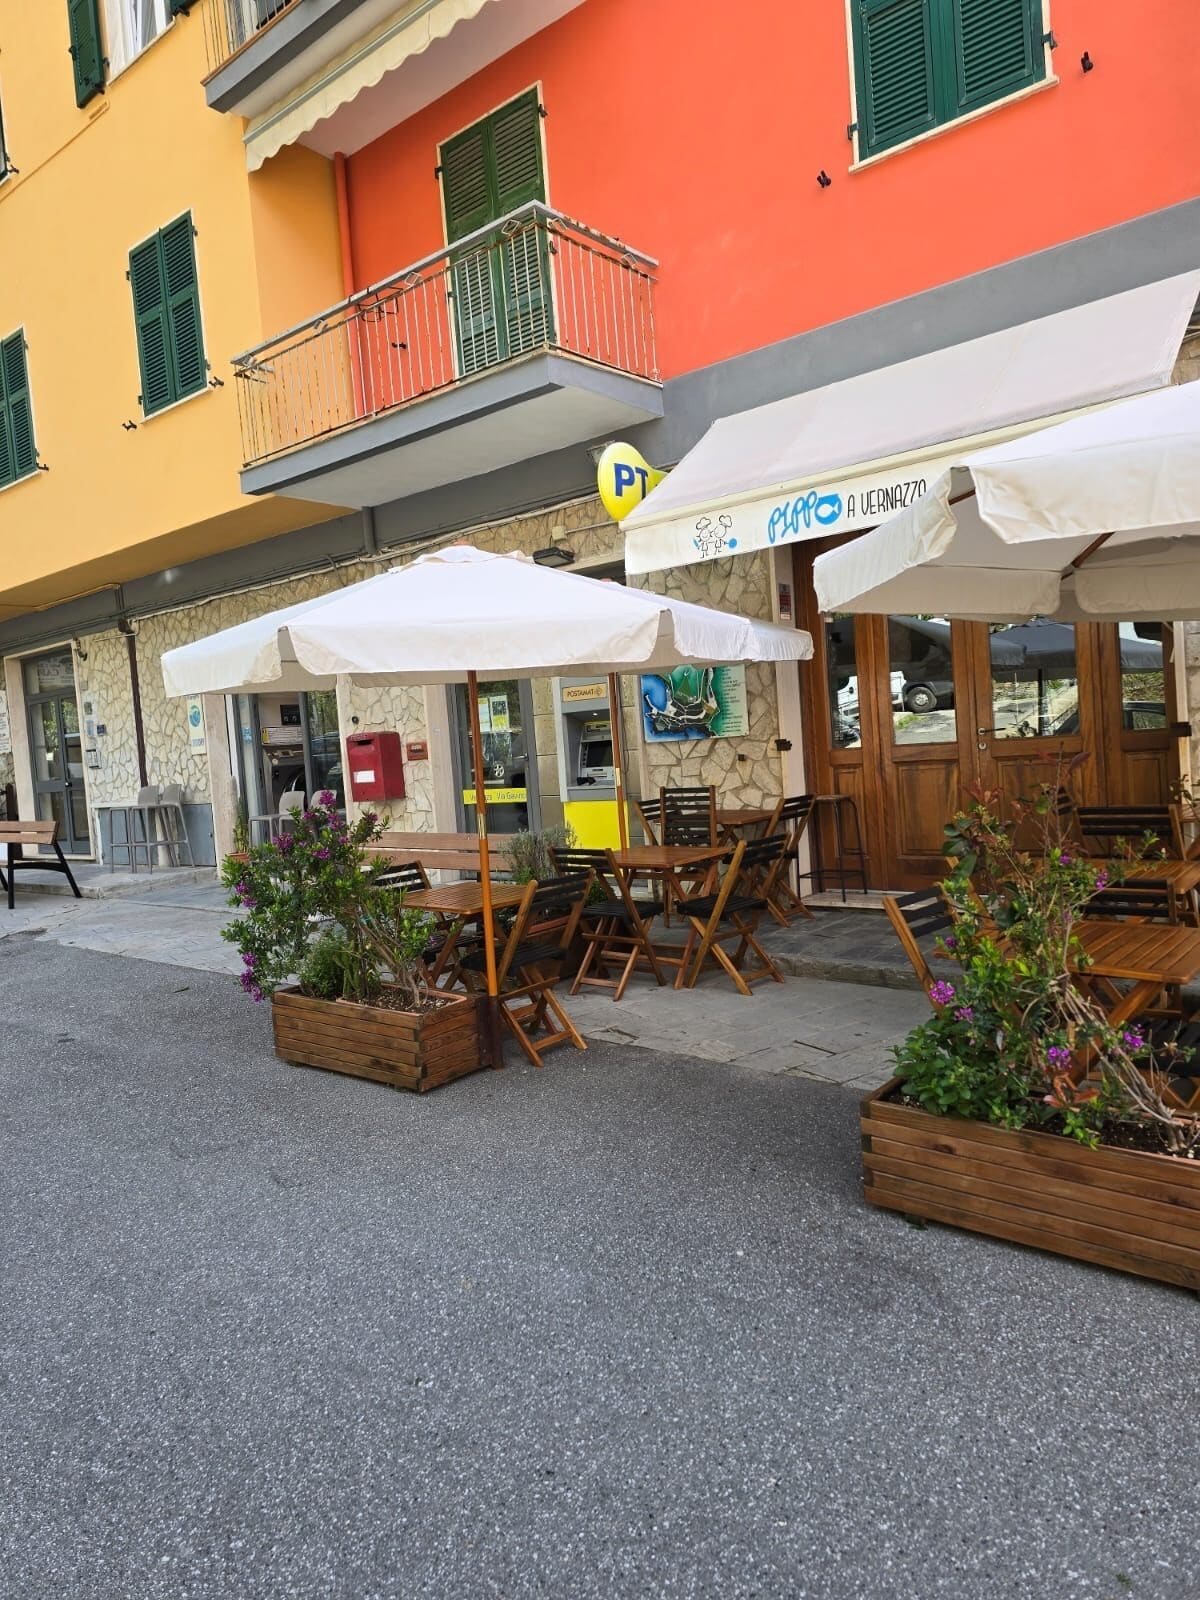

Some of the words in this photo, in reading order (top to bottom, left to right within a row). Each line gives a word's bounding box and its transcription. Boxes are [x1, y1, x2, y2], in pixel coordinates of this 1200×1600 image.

[614, 463, 648, 500] PT
[847, 494, 855, 518] A
[567, 689, 594, 698] POSTAMAT
[496, 792, 505, 800] Via
